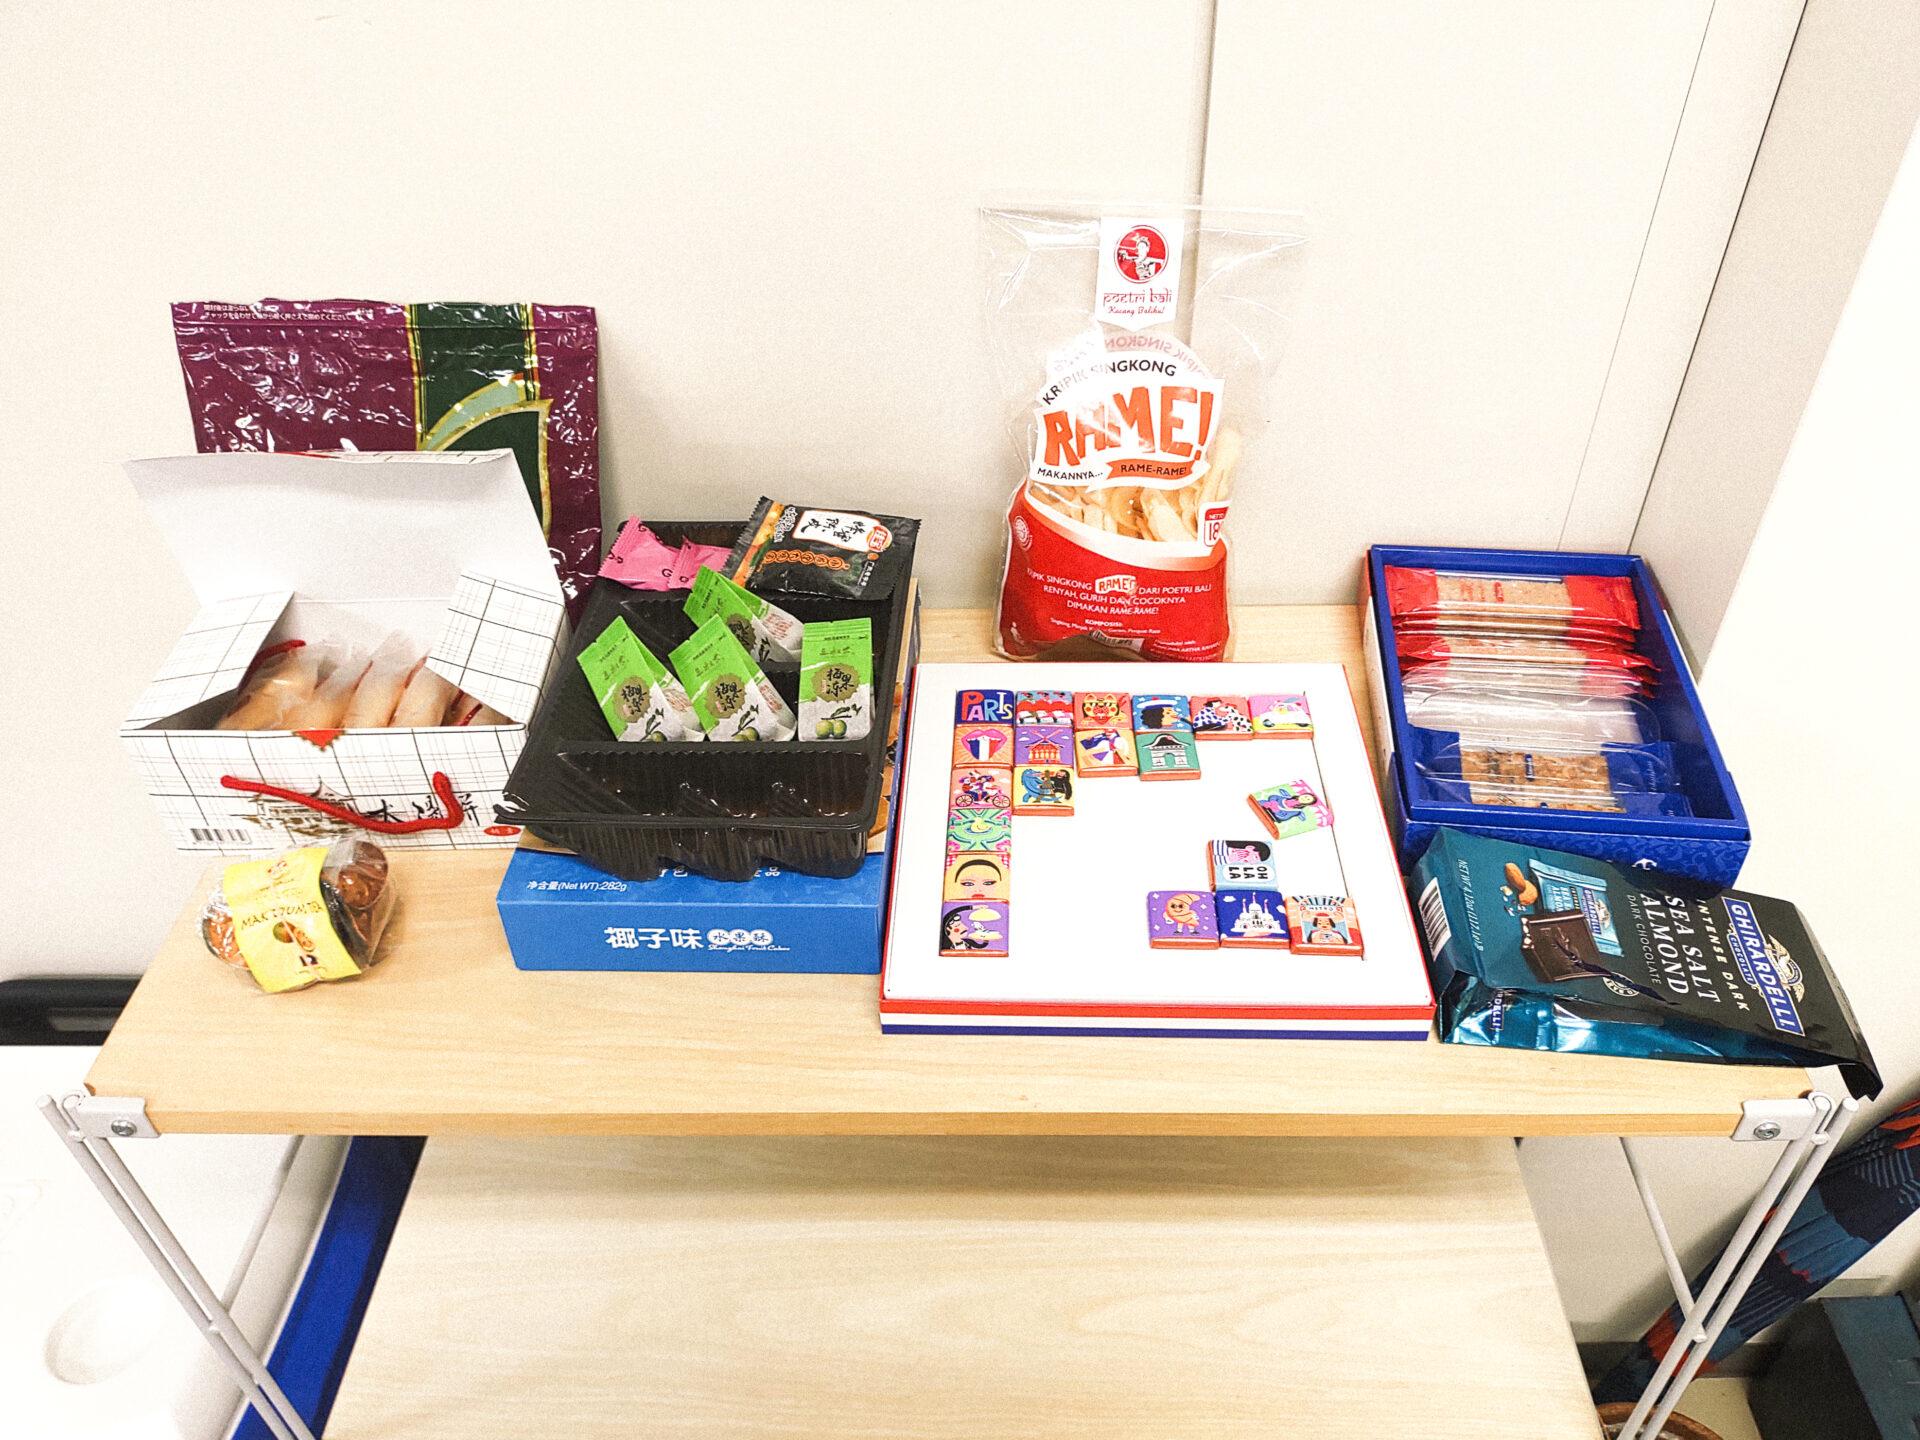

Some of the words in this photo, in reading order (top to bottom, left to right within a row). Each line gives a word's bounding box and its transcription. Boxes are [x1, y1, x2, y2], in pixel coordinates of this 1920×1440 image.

[1103, 289, 1145, 307] poetri
[1149, 288, 1172, 303] bali
[1043, 386, 1214, 467] RAME!
[1037, 467, 1103, 480] MAKANNYA...
[1120, 464, 1187, 476] RAME-RAME!
[1046, 575, 1092, 590] SINGKONG
[1162, 586, 1193, 594] POETRI
[1194, 584, 1212, 593] BALI
[1067, 600, 1108, 613] DIMAKAN
[1080, 592, 1108, 603] GURIH
[1109, 596, 1131, 605] DAN
[1132, 597, 1186, 605] COCOKNYA
[961, 691, 1013, 721] PARIS
[1229, 866, 1241, 880] LA
[1243, 866, 1255, 880] LA
[1257, 866, 1268, 880] OH
[1551, 886, 1564, 911] ALMON
[603, 926, 704, 949] 椰子味
[1627, 894, 1642, 920] DARK
[1637, 923, 1662, 985] CHOCOLATE
[1640, 893, 1690, 994] ALMOND
[1666, 895, 1695, 935] SEA
[1682, 944, 1722, 1003] SALT
[1696, 899, 1728, 964] INTENSE
[1722, 971, 1749, 1011] DARK
[1729, 936, 1754, 983] CHOCOLATE
[1730, 904, 1796, 1027] GHIRARDELLI
